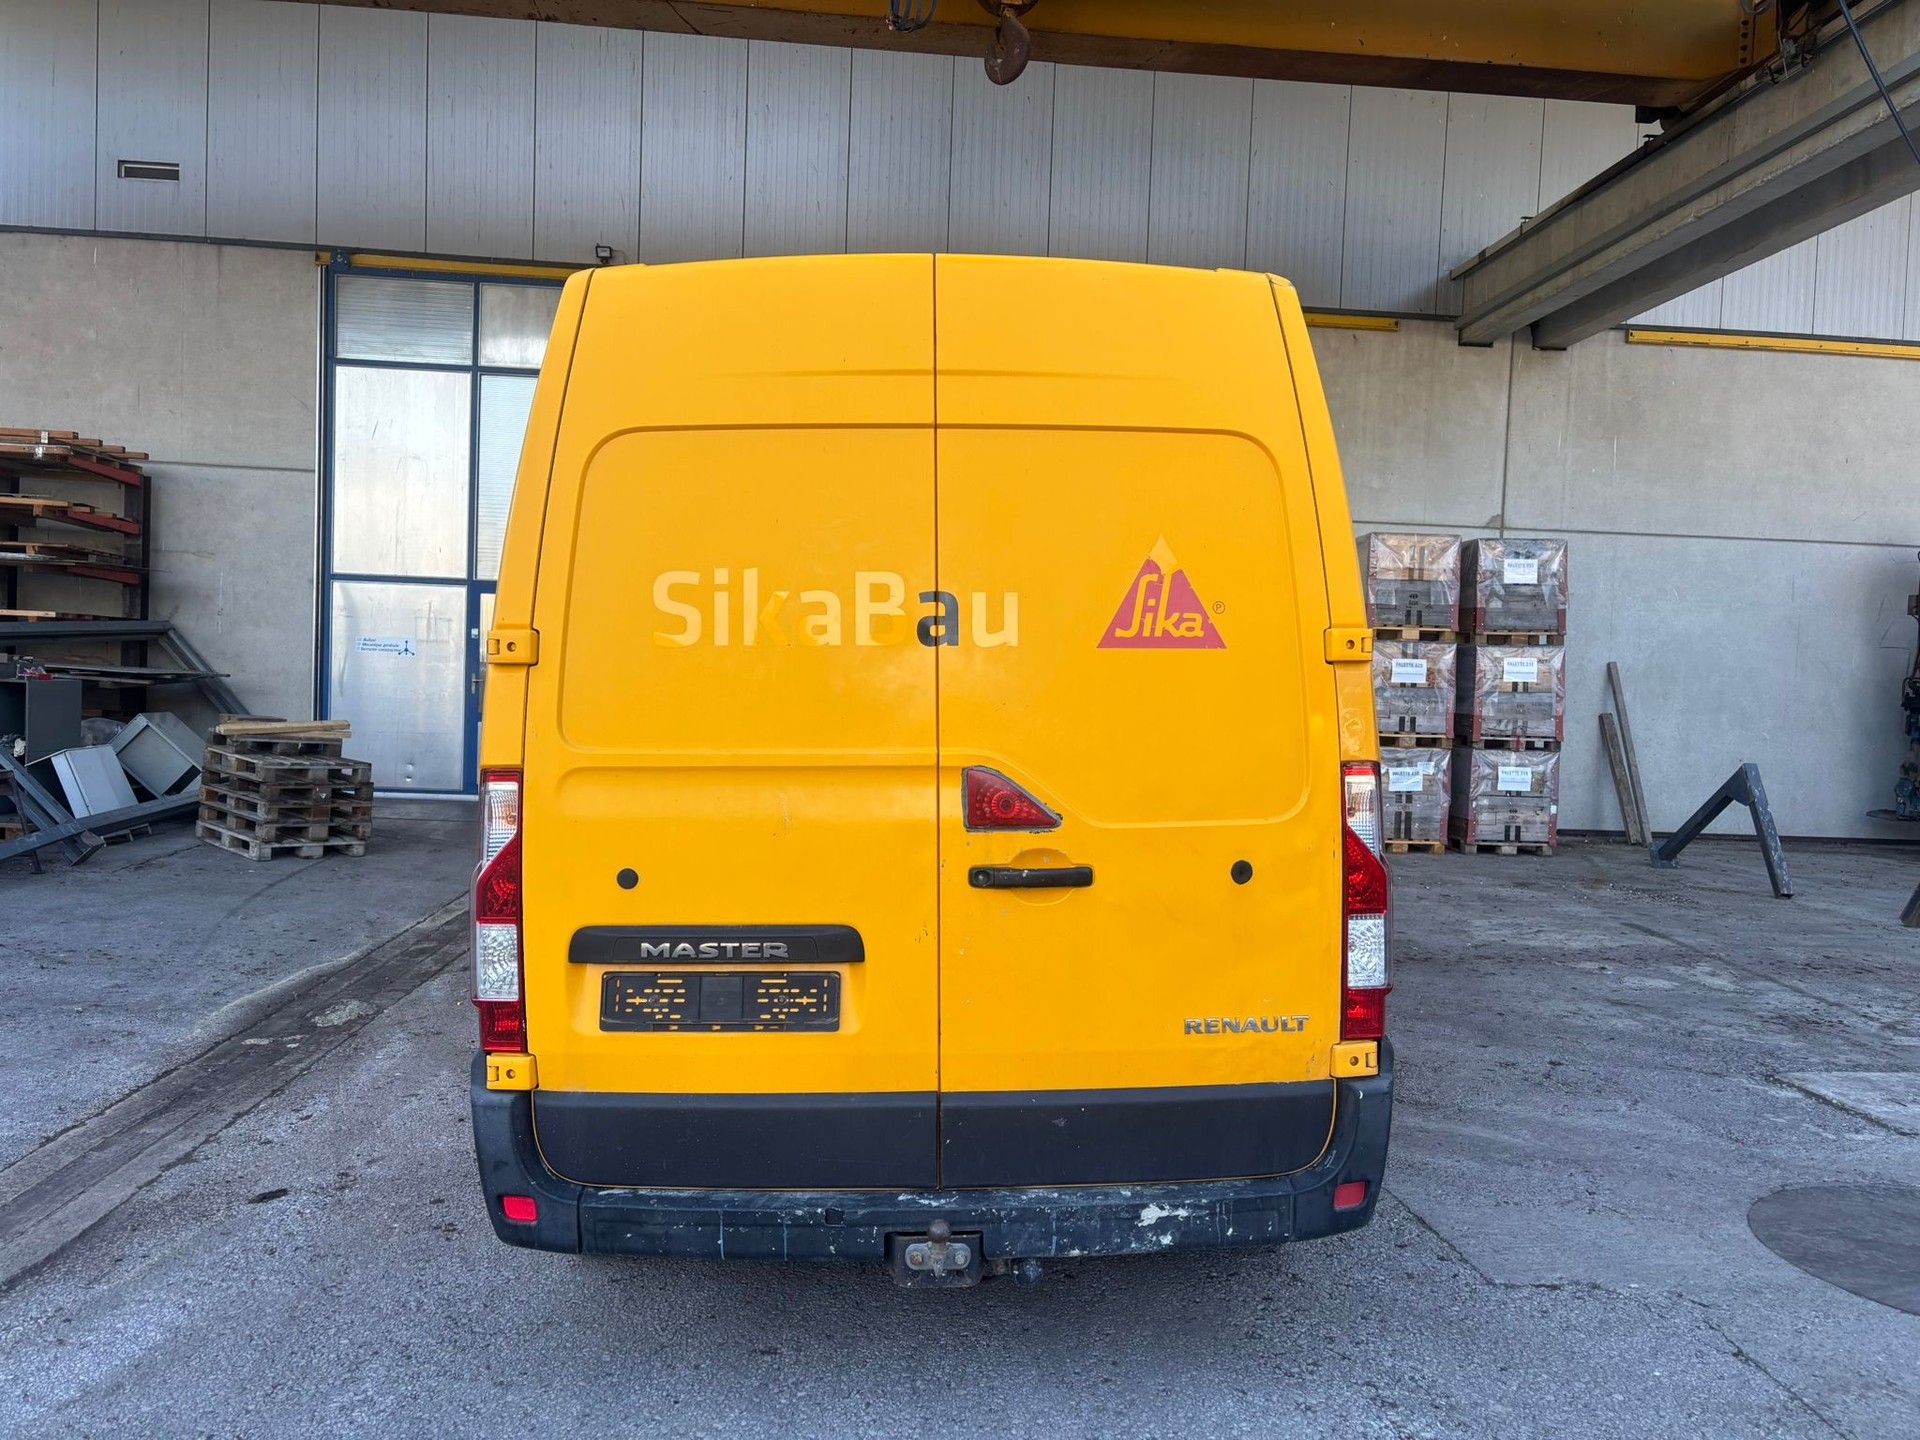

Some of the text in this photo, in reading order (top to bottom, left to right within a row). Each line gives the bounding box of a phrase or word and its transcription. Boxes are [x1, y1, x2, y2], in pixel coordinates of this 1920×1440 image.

[652, 567, 1019, 648] SikaBau
[1115, 573, 1205, 638] Sika
[640, 942, 789, 959] MASTER
[1184, 1015, 1310, 1035] RENAULT
